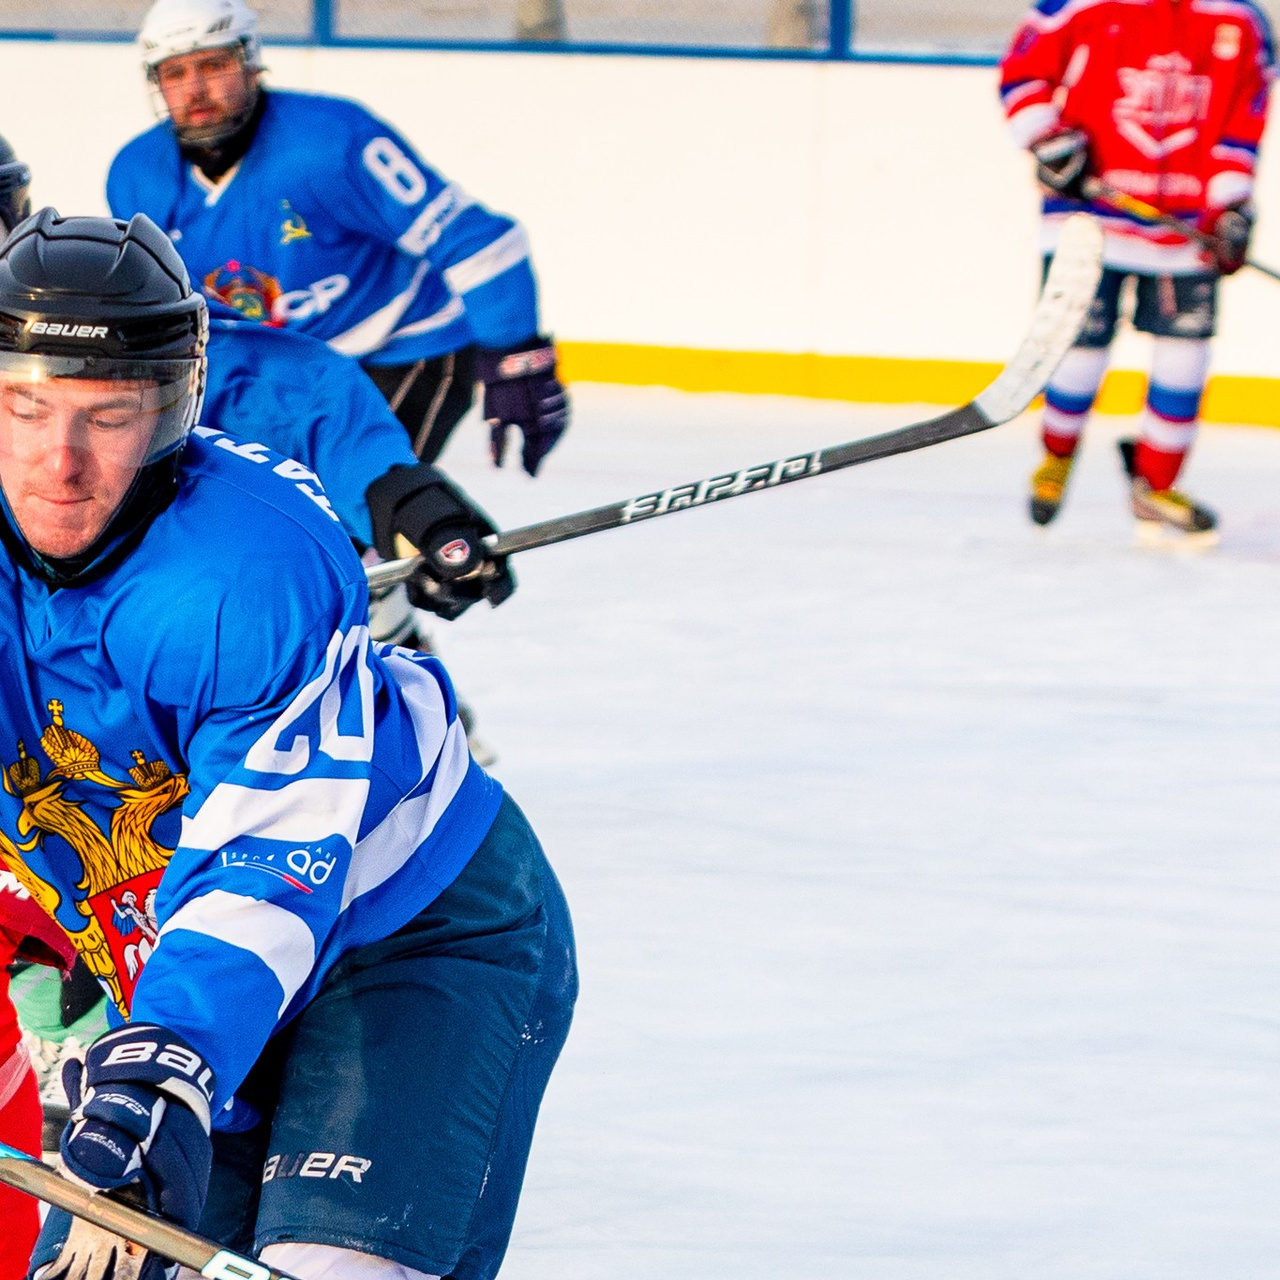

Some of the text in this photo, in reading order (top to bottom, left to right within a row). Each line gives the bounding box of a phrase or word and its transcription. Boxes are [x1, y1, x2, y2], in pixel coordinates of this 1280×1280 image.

[362, 136, 427, 206] 8
[30, 321, 109, 339] BAUER
[243, 625, 375, 776] 20
[262, 1152, 372, 1184] AUER
